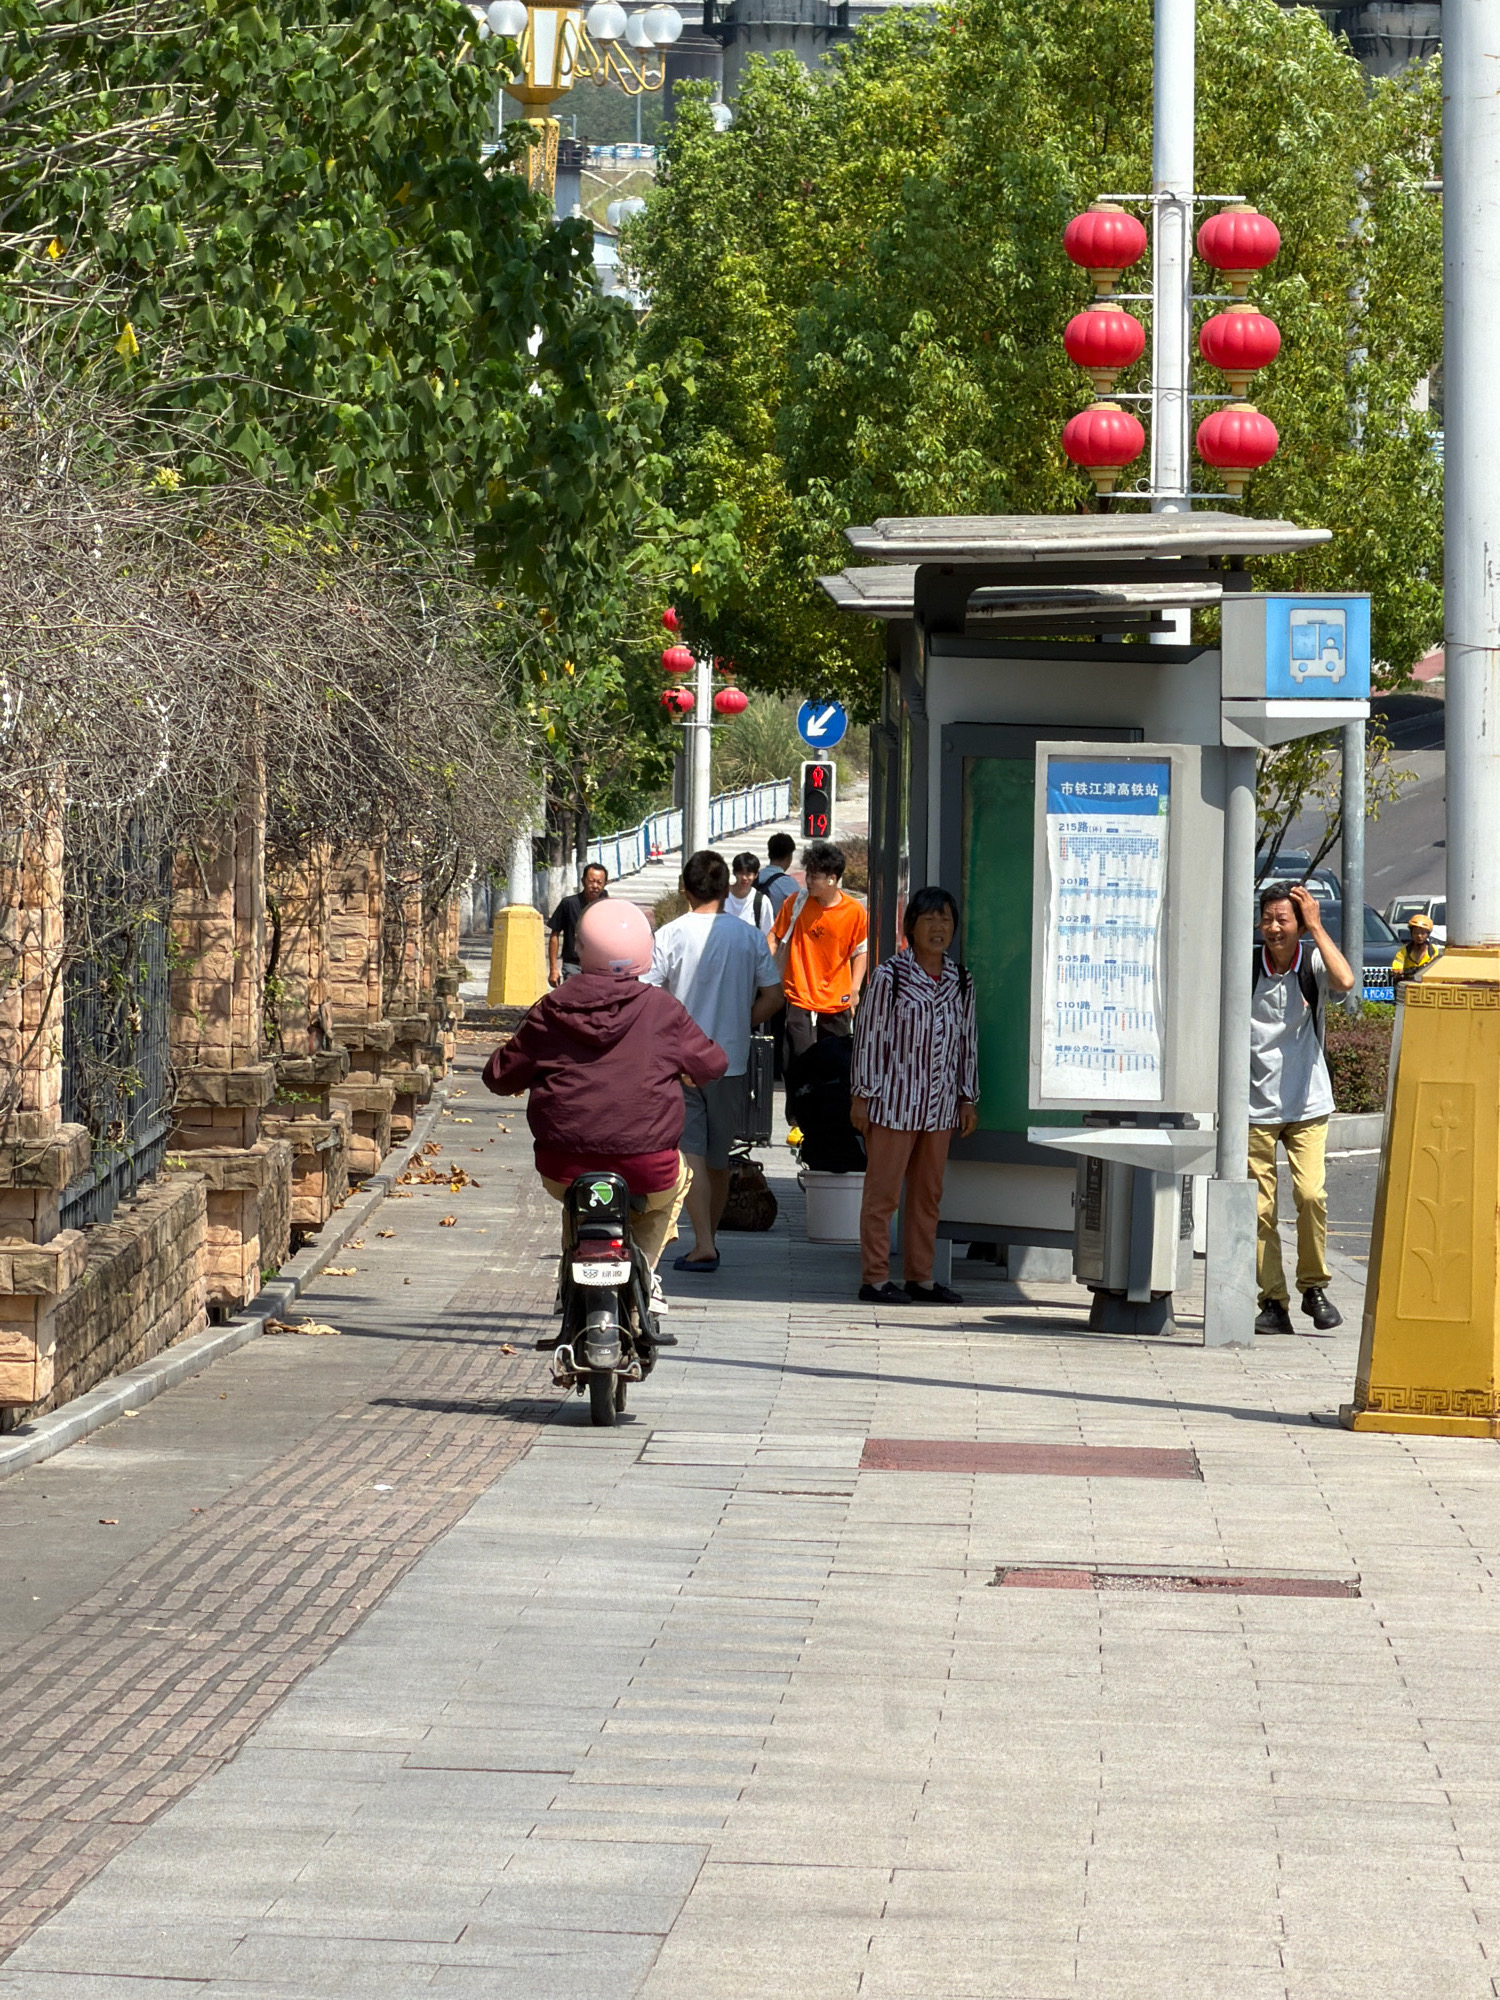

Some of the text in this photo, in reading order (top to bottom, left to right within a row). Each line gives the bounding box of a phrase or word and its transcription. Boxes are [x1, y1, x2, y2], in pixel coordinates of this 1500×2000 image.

[1060, 782, 1159, 797] 市铁江津高铁站
[808, 814, 827, 837] 19
[1060, 877, 1089, 887] 301路
[1058, 914, 1091, 923] 302路
[1057, 954, 1091, 964] 505路
[1056, 1001, 1091, 1010] C101路
